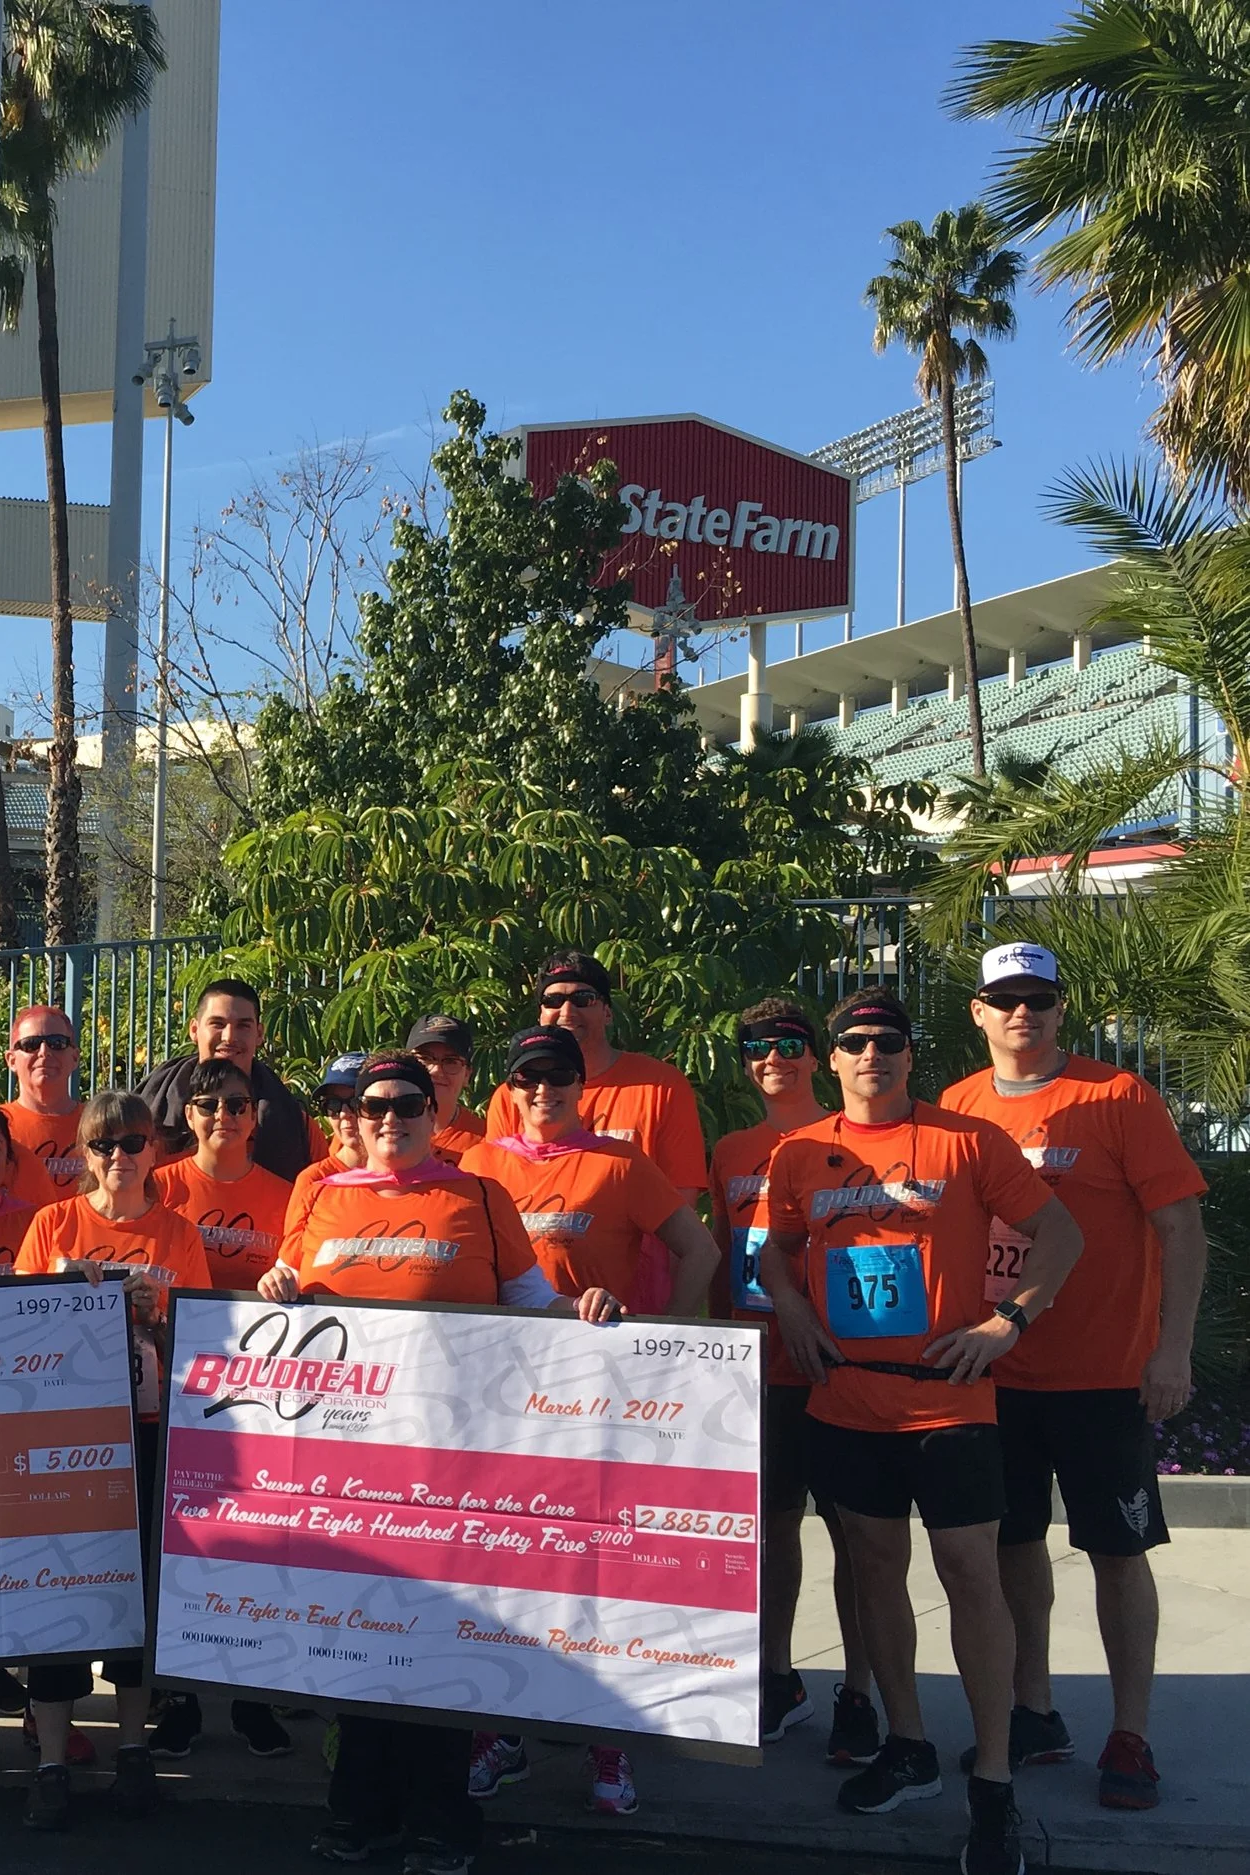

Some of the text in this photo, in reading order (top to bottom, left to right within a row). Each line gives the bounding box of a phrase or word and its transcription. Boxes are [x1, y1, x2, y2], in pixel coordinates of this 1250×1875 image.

[848, 1274, 899, 1310] 975
[16, 1294, 118, 1316] 1997-2017
[632, 1338, 752, 1362] 1997-2017
[12, 1353, 64, 1375] 2017
[179, 1351, 399, 1398] BOUDREAU
[43, 1379, 67, 1388] DATE
[220, 1389, 388, 1410] PIPELINE CORPORATION
[524, 1391, 685, 1422] March 11, 2017
[322, 1408, 374, 1430] years
[658, 1430, 686, 1440] DATE
[45, 1446, 115, 1471] 5,000
[174, 1469, 225, 1481] PAY TO THE
[28, 1491, 71, 1502] DOLLARS
[251, 1469, 576, 1518] Susan G. Komen Race for the Cure
[170, 1493, 634, 1555] Two Thousand Eight Hundred Eighty Five 3/100
[632, 1552, 681, 1566] DOLLARS
[35, 1567, 138, 1591] Corporation
[183, 1592, 419, 1634] FOR The Fight to End Cancer!
[456, 1619, 738, 1670] Boudreau Pipeline Corporation
